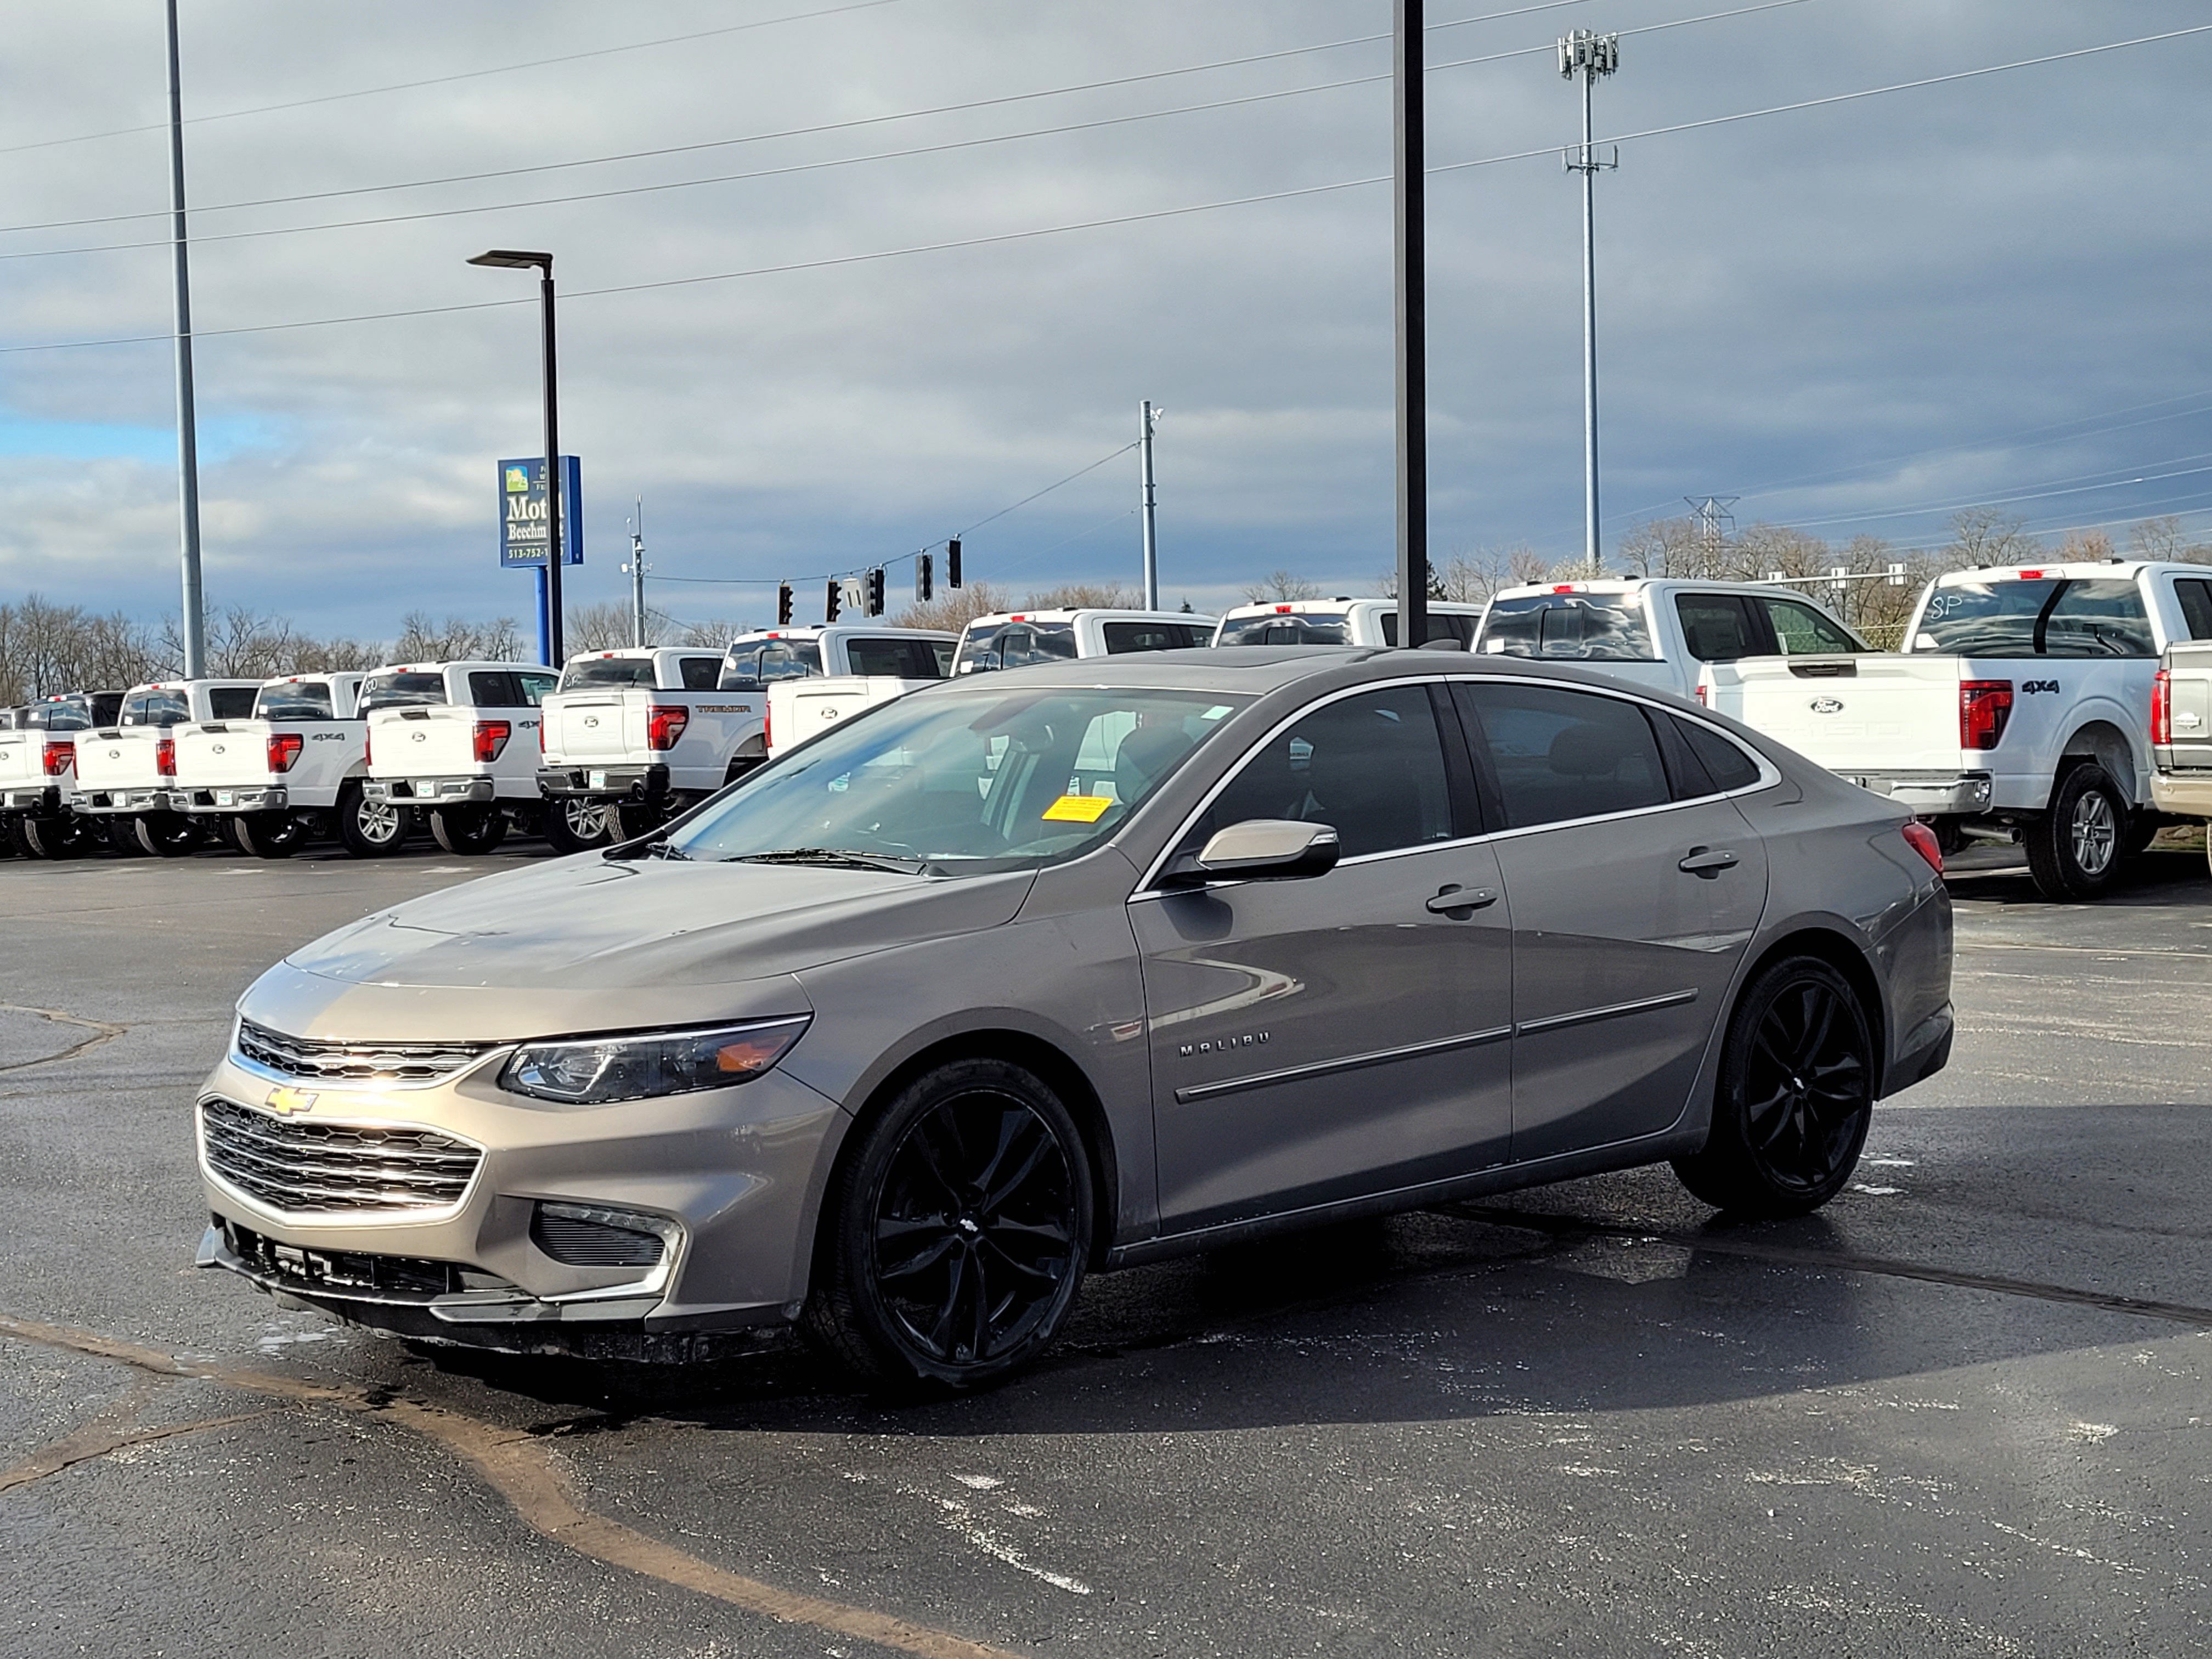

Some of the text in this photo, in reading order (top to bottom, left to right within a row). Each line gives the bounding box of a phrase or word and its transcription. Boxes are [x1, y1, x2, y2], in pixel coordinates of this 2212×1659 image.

[506, 492, 565, 521] Motl
[507, 521, 564, 541] Beechmt
[517, 720, 541, 730] 4X
[1180, 1031, 1269, 1057] MALIBU
